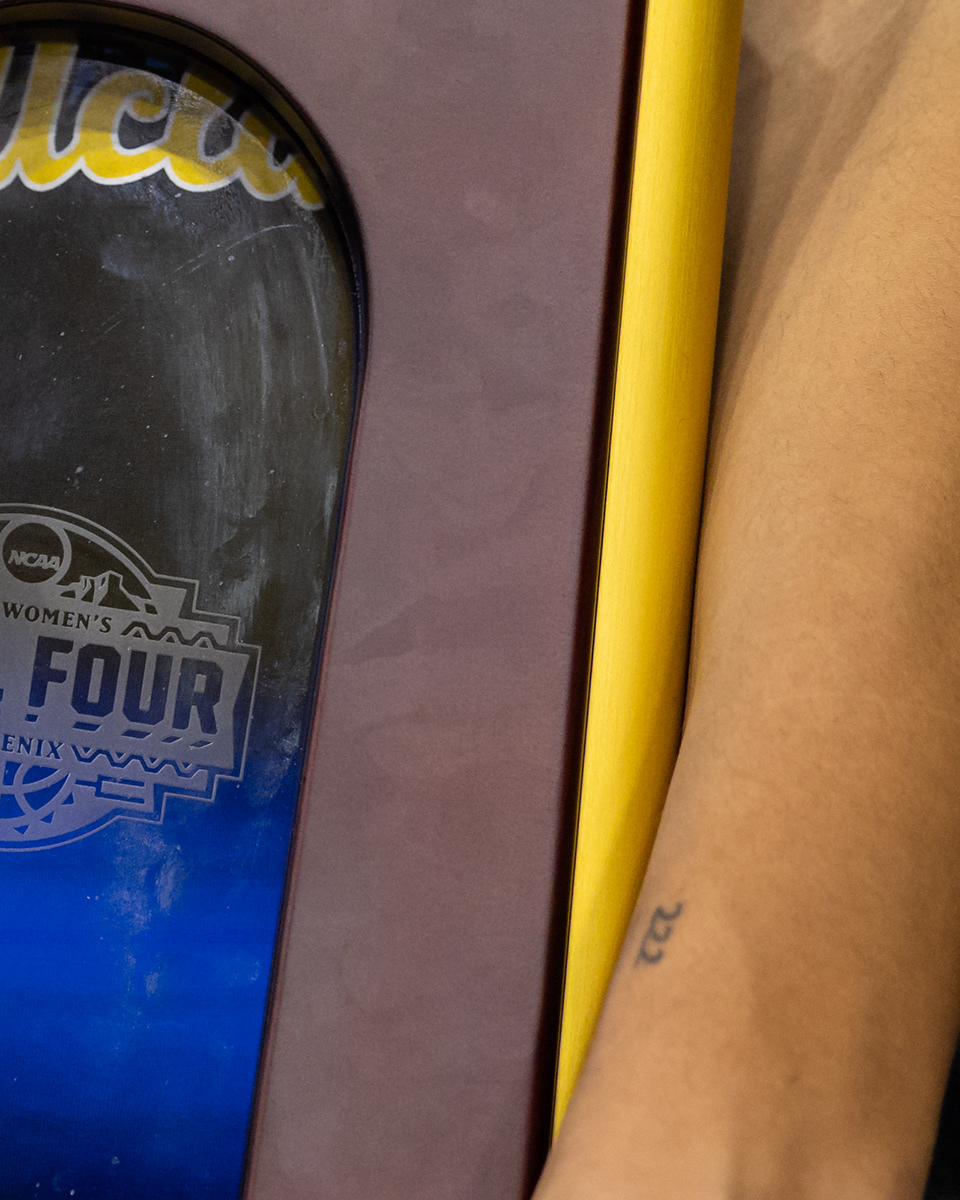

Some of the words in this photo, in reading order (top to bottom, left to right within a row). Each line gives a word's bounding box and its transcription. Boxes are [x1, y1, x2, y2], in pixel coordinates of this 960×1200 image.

[8, 549, 61, 572] NCAA
[2, 601, 112, 634] WOMEN'S
[28, 634, 224, 735] FOUR
